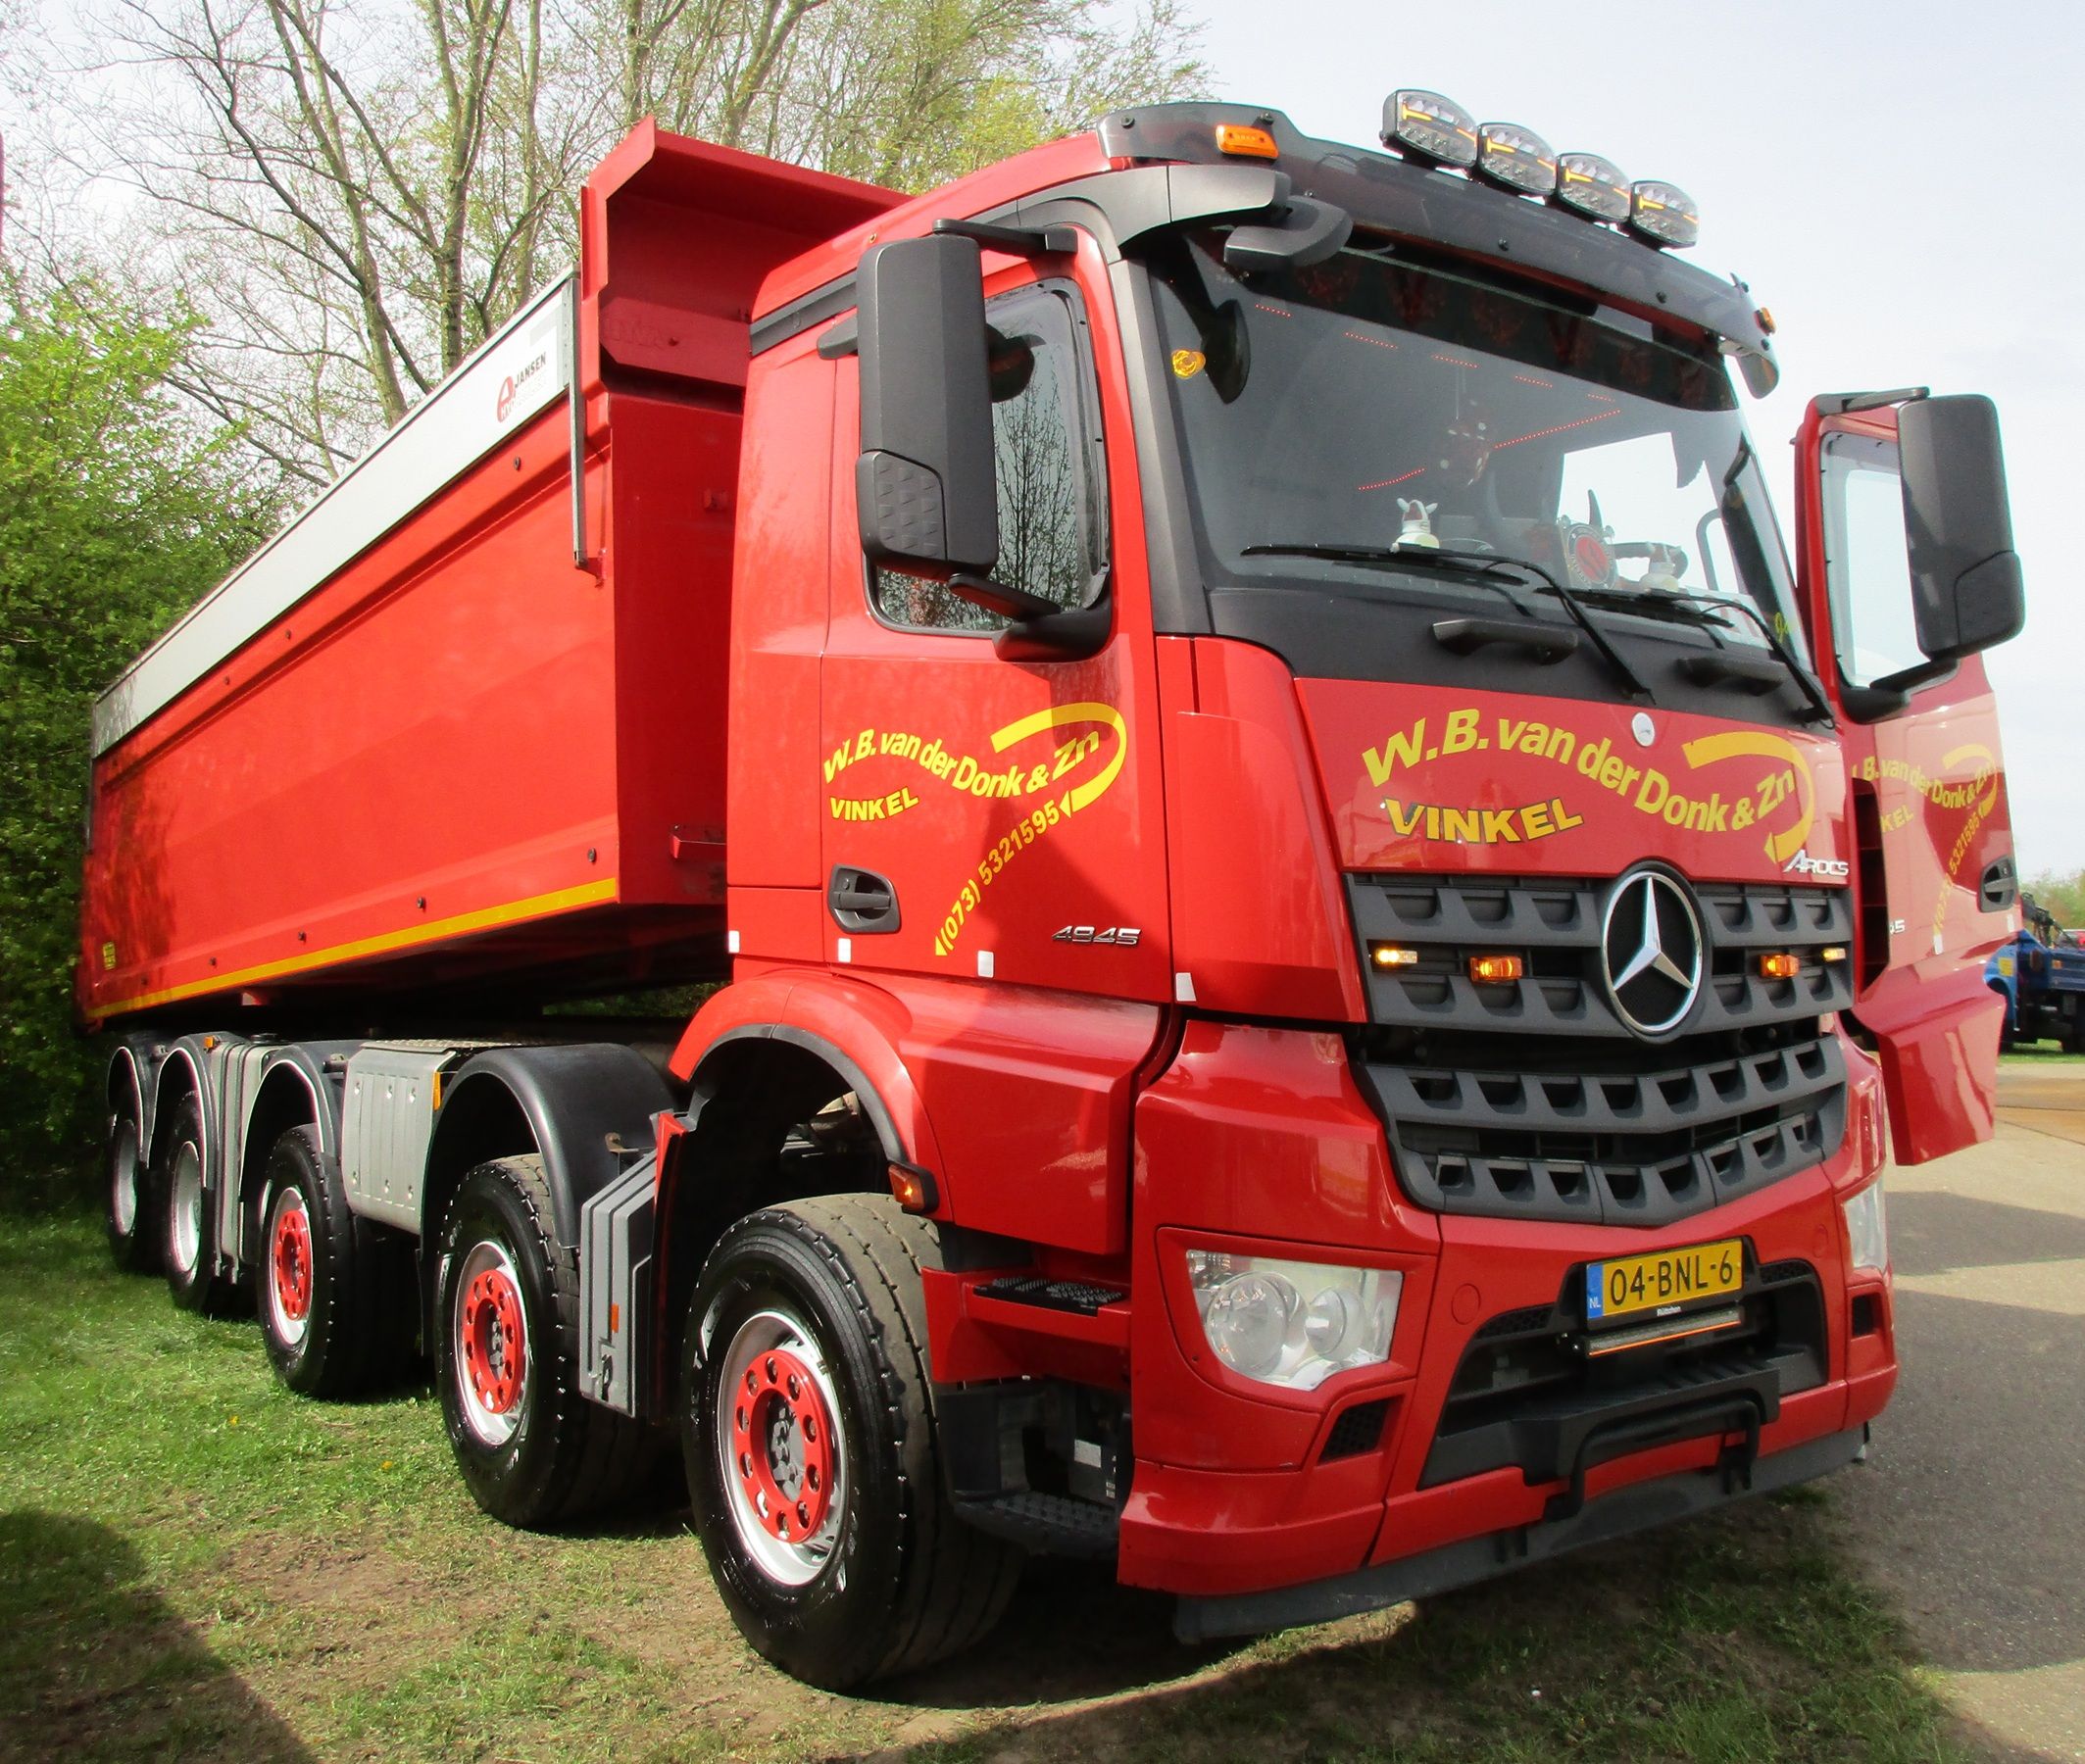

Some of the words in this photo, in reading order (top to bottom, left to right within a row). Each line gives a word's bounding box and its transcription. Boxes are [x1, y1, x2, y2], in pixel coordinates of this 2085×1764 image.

[515, 352, 547, 388] JANSEN
[879, 732, 922, 759] van
[919, 739, 957, 780] der
[952, 756, 1026, 798] Donk
[1025, 764, 1050, 794] &
[1051, 731, 1100, 781] Zn
[1498, 718, 1573, 763] van
[1576, 737, 1641, 797] der
[1633, 768, 1728, 832] Donk
[1731, 798, 1755, 830] &
[1756, 769, 1795, 820] Zn
[1881, 759, 1911, 781] van
[1931, 779, 1966, 808] Donk
[830, 786, 919, 821] VINKEL
[1383, 797, 1584, 845] VINKEL
[1881, 805, 1914, 833] KEL
[939, 879, 981, 950] (073)
[977, 800, 1060, 885] 5321595
[1052, 925, 1141, 945] 4945
[1611, 1250, 1733, 1305] 04-BNL-6
[1589, 1297, 1601, 1308] NL
